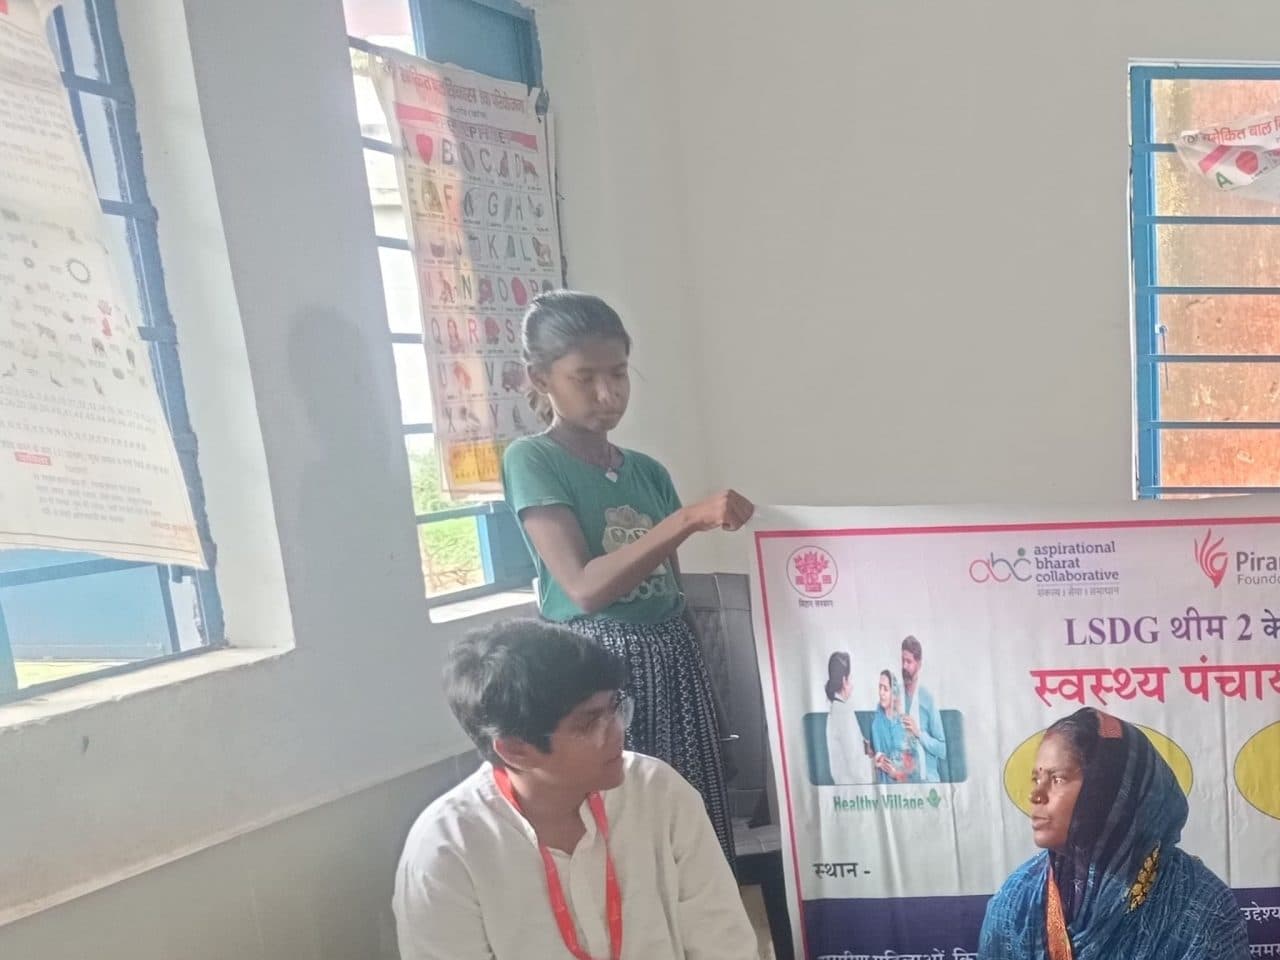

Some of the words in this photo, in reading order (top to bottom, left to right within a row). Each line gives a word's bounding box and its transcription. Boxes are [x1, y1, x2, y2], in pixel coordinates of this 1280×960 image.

[479, 148, 492, 173] C
[1216, 171, 1233, 188] A
[488, 191, 499, 217] G
[488, 234, 499, 259] K
[461, 274, 472, 300] N
[431, 317, 442, 345] Q
[467, 318, 480, 345] R
[505, 318, 516, 344] S
[484, 360, 495, 386] V
[1034, 541, 1116, 558] aspirational
[1035, 557, 1080, 570] bharat
[1035, 571, 1120, 583] collaborative
[1064, 616, 1160, 646] LSDG
[1170, 606, 1227, 641] थीम
[1238, 613, 1253, 642] 2
[813, 861, 859, 878] स्थान
